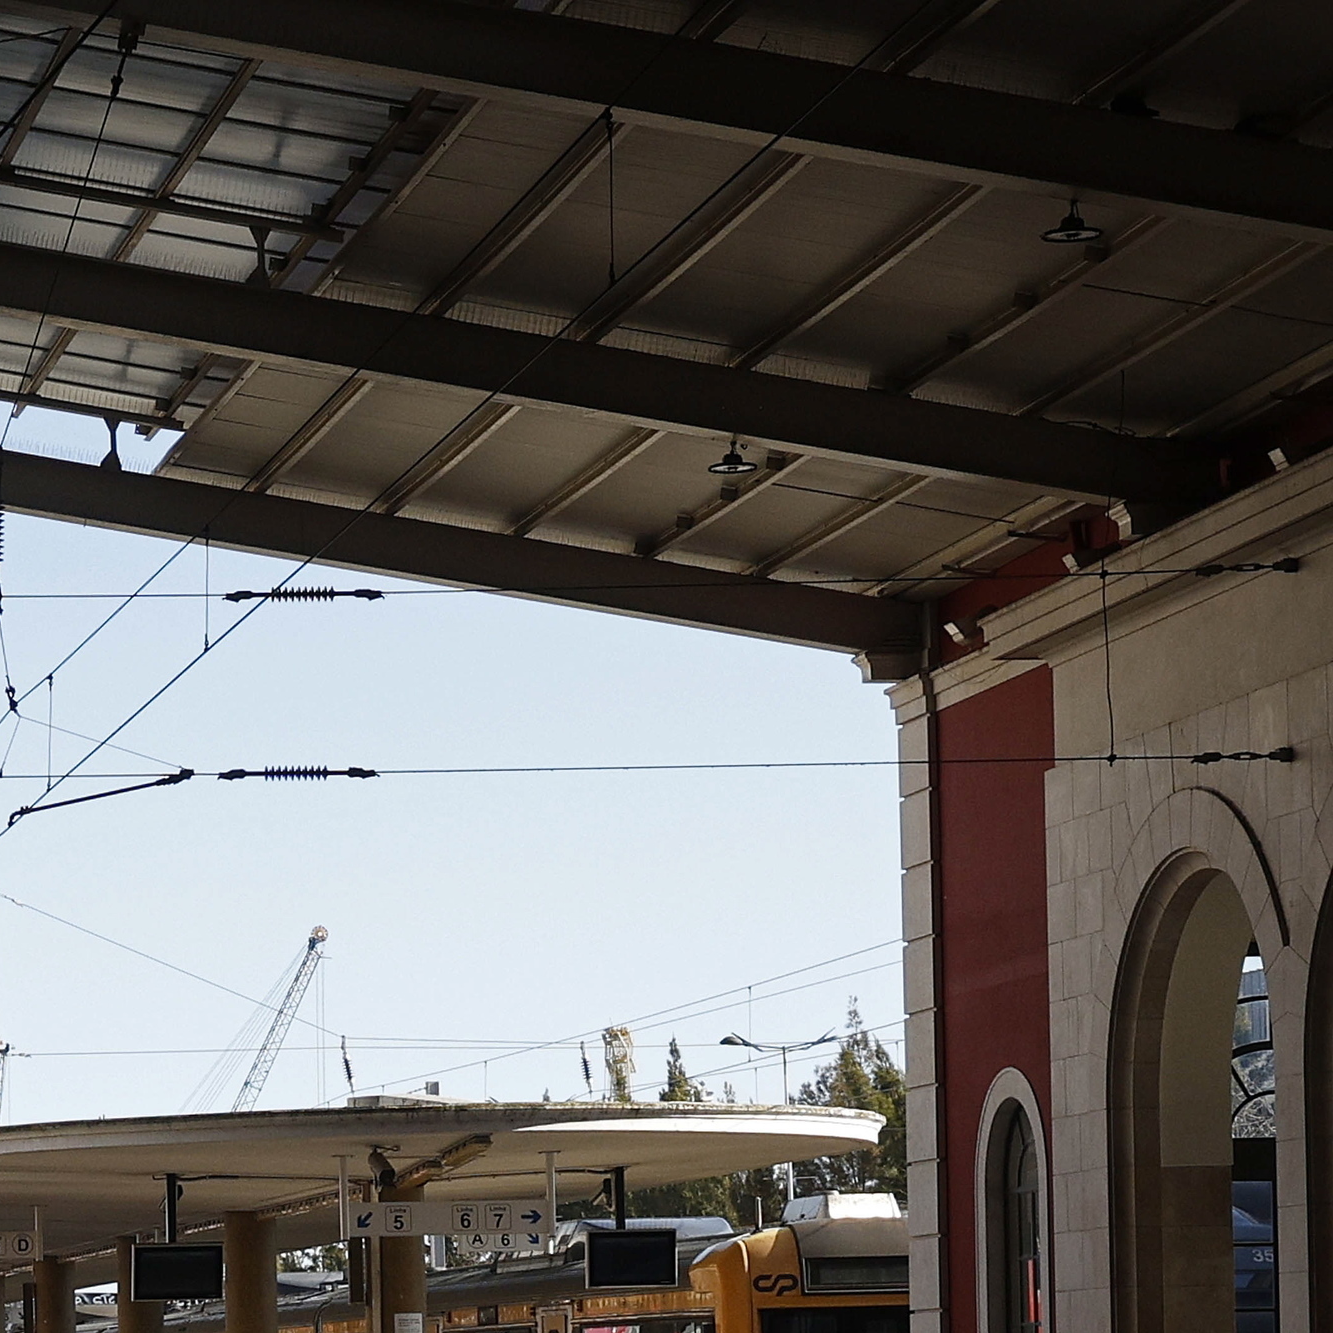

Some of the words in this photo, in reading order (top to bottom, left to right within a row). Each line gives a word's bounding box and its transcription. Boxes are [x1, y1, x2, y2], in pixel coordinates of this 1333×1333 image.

[393, 1215, 405, 1230] 5
[460, 1213, 471, 1228] 6
[493, 1213, 504, 1228] 7
[17, 1240, 29, 1252] D
[471, 1234, 484, 1244] A
[501, 1234, 511, 1246] 6
